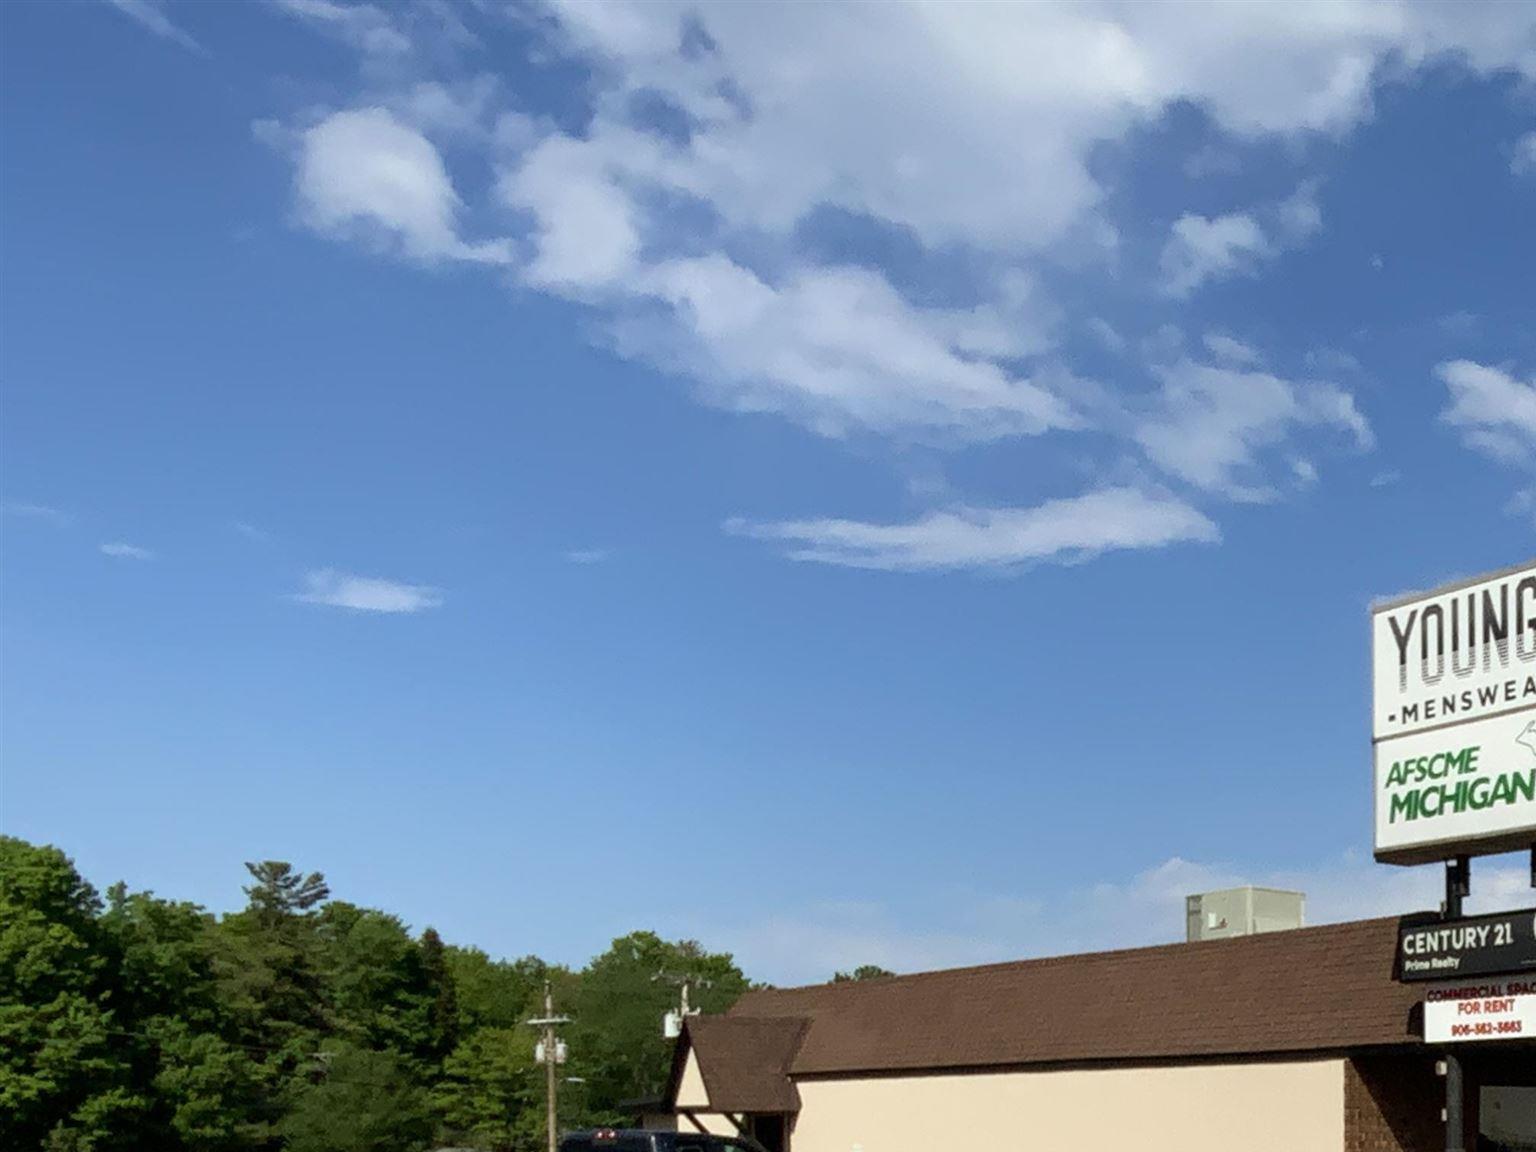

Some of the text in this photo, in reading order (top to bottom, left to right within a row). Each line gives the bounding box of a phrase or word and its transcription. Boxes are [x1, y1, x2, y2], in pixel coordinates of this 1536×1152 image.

[1385, 746, 1481, 787] AFSCME
[1388, 768, 1536, 823] MICHIGAN
[1403, 922, 1514, 954] CENTURY 21
[1431, 956, 1460, 970] Realty
[1427, 985, 1502, 1003] COMMERCIAL
[1458, 999, 1515, 1015] FOR RENT
